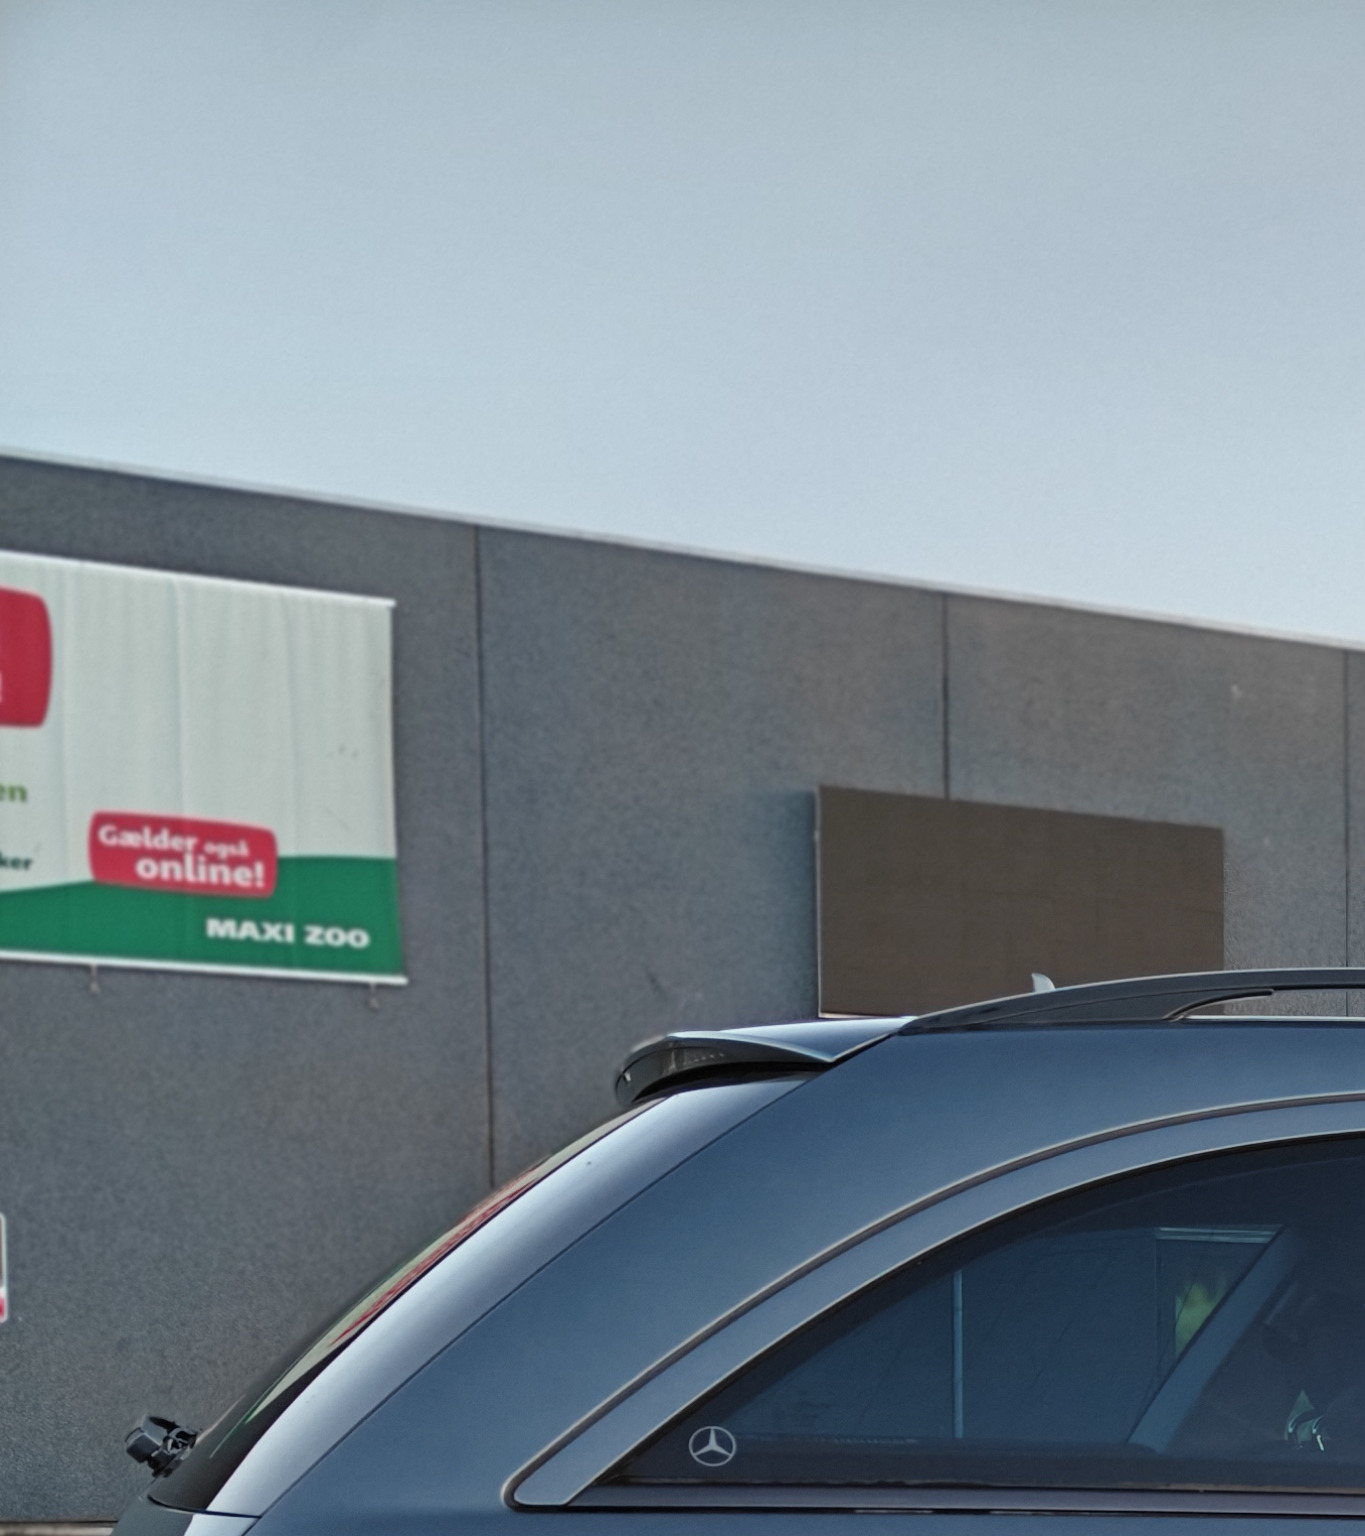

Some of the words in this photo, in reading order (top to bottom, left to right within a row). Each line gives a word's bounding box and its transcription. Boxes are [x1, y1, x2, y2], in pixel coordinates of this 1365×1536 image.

[98, 824, 198, 851] Gælder
[203, 838, 250, 859] også
[135, 851, 265, 888] online!
[206, 917, 295, 944] MAXI
